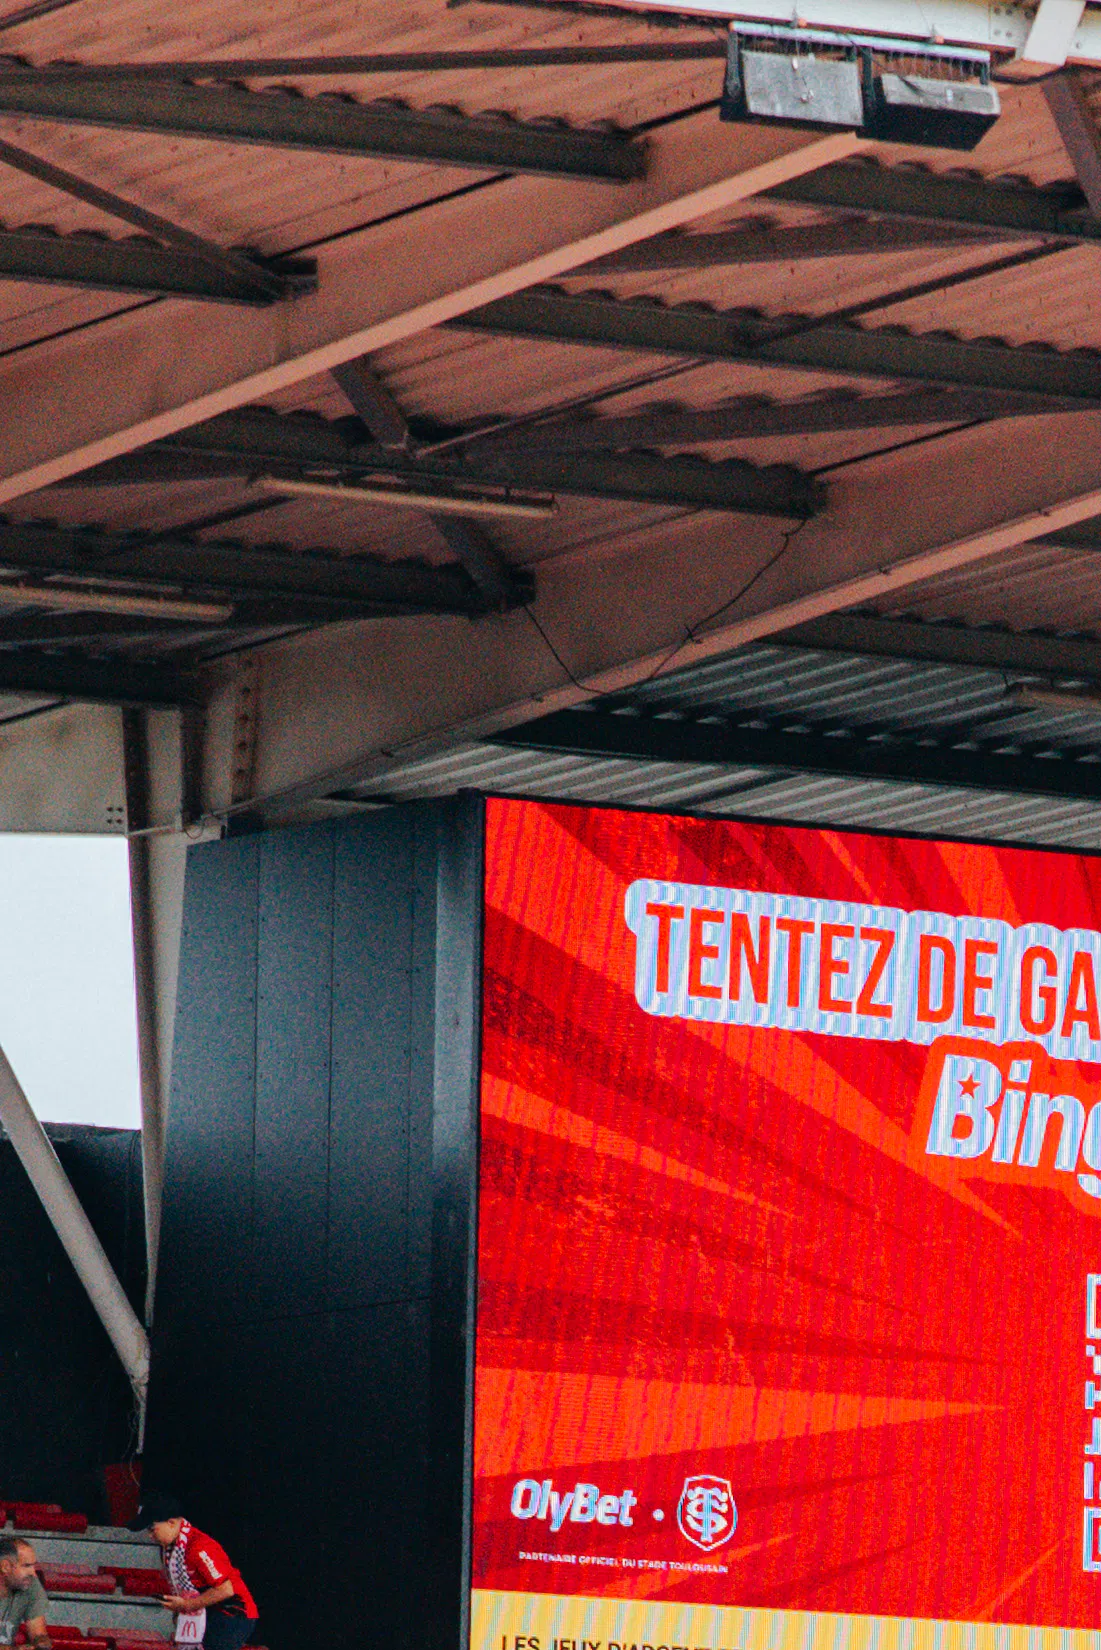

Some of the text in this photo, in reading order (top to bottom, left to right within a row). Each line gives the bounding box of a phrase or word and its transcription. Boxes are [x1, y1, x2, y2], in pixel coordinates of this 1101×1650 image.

[645, 902, 896, 1019] TENTEZ
[916, 934, 999, 1030] DE
[510, 1478, 638, 1532] OlyBet
